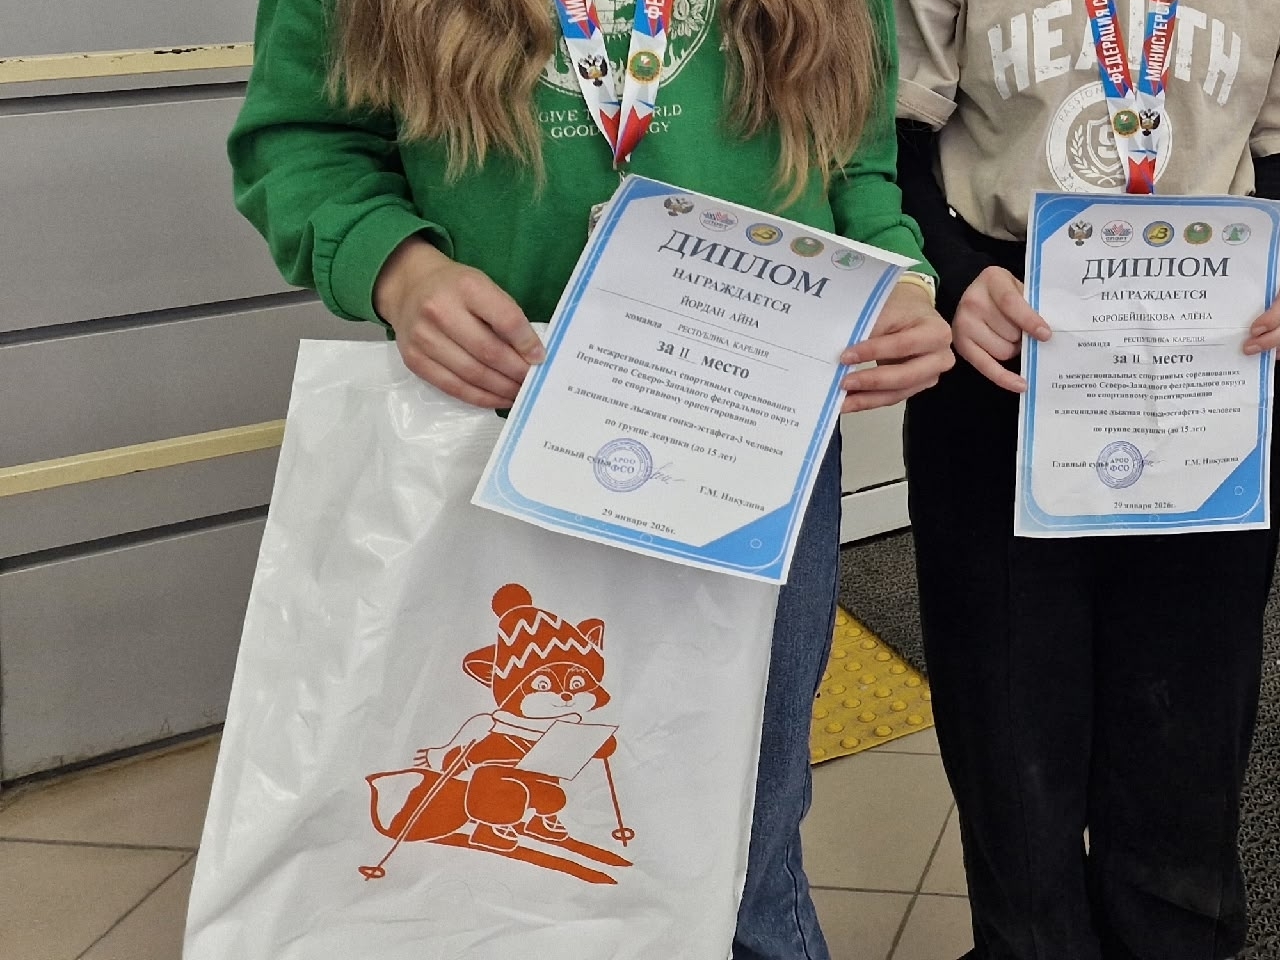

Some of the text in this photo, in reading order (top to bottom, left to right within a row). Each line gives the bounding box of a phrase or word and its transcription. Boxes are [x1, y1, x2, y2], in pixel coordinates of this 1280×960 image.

[1096, 8, 1124, 83] ФЕДЕРАЦИЯ
[539, 110, 578, 122] GIVE
[652, 104, 682, 118] RLD
[657, 229, 831, 298] ДИПЛОМ
[1081, 257, 1231, 285] ДИПЛОМ
[672, 267, 792, 314] НАГРАЖДАЕТСЯ
[1101, 290, 1207, 301] НАГРАЖДАЕТСЯ
[680, 295, 760, 328] ЙОРДАН АЙНА
[1092, 312, 1175, 323] КОРОБЕЙНИКОВА
[625, 312, 769, 359] команда РЕСПУБЛИКА КАРЕЛИЯ
[1077, 341, 1111, 349] команда
[1123, 336, 1169, 344] РЕСПУБЛИКА
[656, 340, 674, 356] за
[701, 355, 750, 379] место
[1113, 354, 1127, 364] за
[1152, 353, 1194, 365] место
[596, 346, 677, 378] межрегиональных
[679, 372, 732, 394] спортивных
[733, 388, 797, 414] соревнованиях
[1052, 381, 1097, 390] Первенство
[1169, 380, 1220, 390] федерального
[1221, 379, 1246, 387] округа
[1065, 373, 1137, 382] межрегиональных
[576, 351, 800, 429] Первенство Северо-Западного федерального округа
[1097, 392, 1148, 400] спортивному
[612, 376, 757, 427] по спортивному ориентированию
[574, 386, 629, 410] дисциплине
[630, 404, 667, 421] лыжная
[745, 440, 784, 456] человека
[543, 441, 584, 460] Главный
[605, 418, 737, 463] по группе девушки (до 15 лет)
[610, 464, 635, 474] ФСО
[1109, 464, 1130, 472] ФСО
[721, 492, 765, 512] Никулина
[602, 508, 613, 517] 29
[615, 513, 648, 527] января
